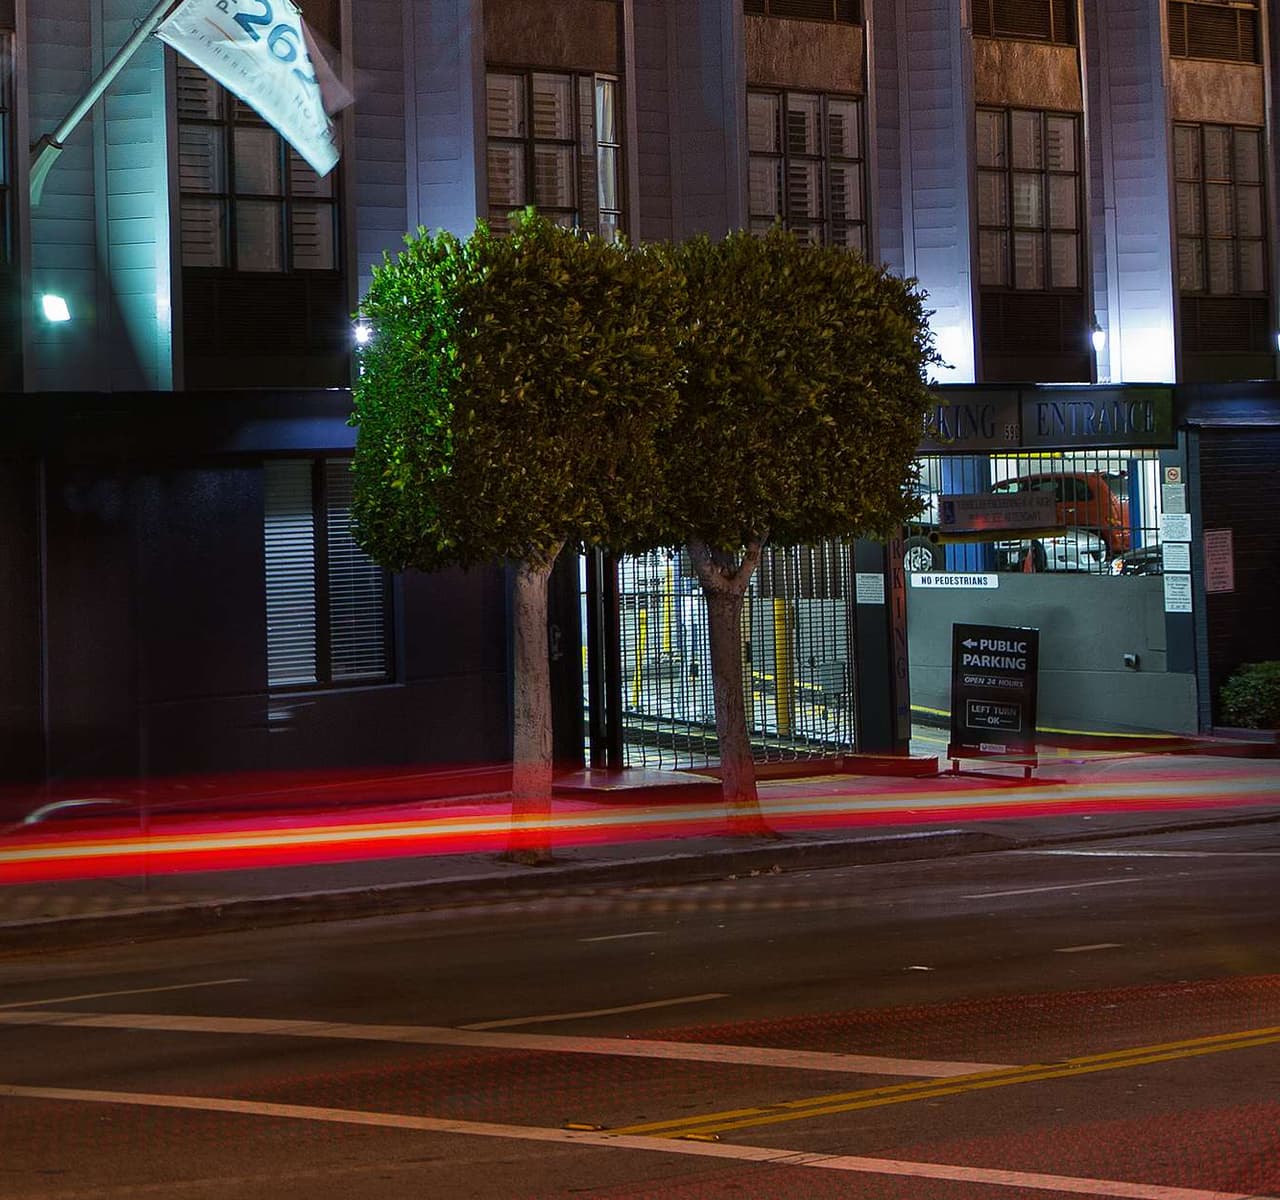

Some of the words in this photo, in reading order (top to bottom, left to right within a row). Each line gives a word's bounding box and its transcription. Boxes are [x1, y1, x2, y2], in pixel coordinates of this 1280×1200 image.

[1036, 399, 1157, 438] ENTRANCE
[921, 575, 932, 585] NO
[935, 575, 989, 586] PEDESTRIANS
[980, 639, 1027, 654] PUBLIC
[962, 653, 1027, 671] PARKING
[964, 676, 985, 685] OPEN
[986, 678, 997, 686] 24
[998, 679, 1025, 688] HOURS
[971, 704, 991, 714] LEFT
[994, 706, 1017, 716] TURN
[987, 715, 1000, 725] OK
